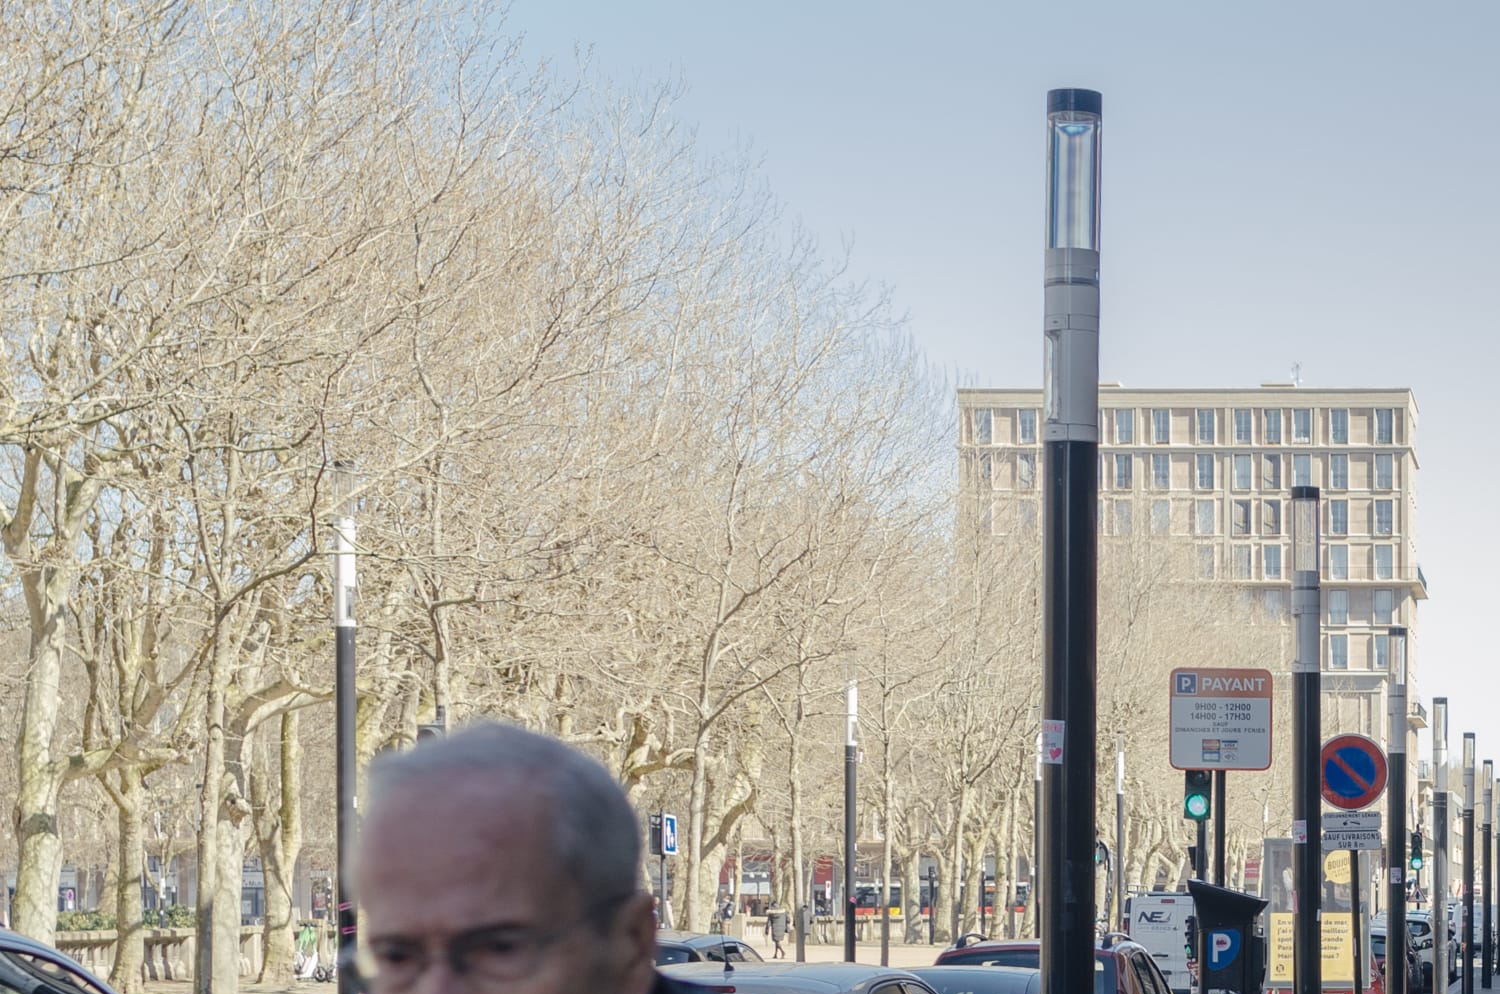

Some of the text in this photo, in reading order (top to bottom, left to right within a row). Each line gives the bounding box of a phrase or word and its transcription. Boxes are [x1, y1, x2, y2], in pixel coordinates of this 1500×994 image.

[1181, 677, 1265, 692] P PAYANT
[1195, 703, 1216, 711] 9H00
[1224, 703, 1251, 711] 12H00
[1190, 712, 1216, 720] 14H00
[1224, 713, 1251, 721] 17H30
[1342, 832, 1380, 841] LIVRAISONS
